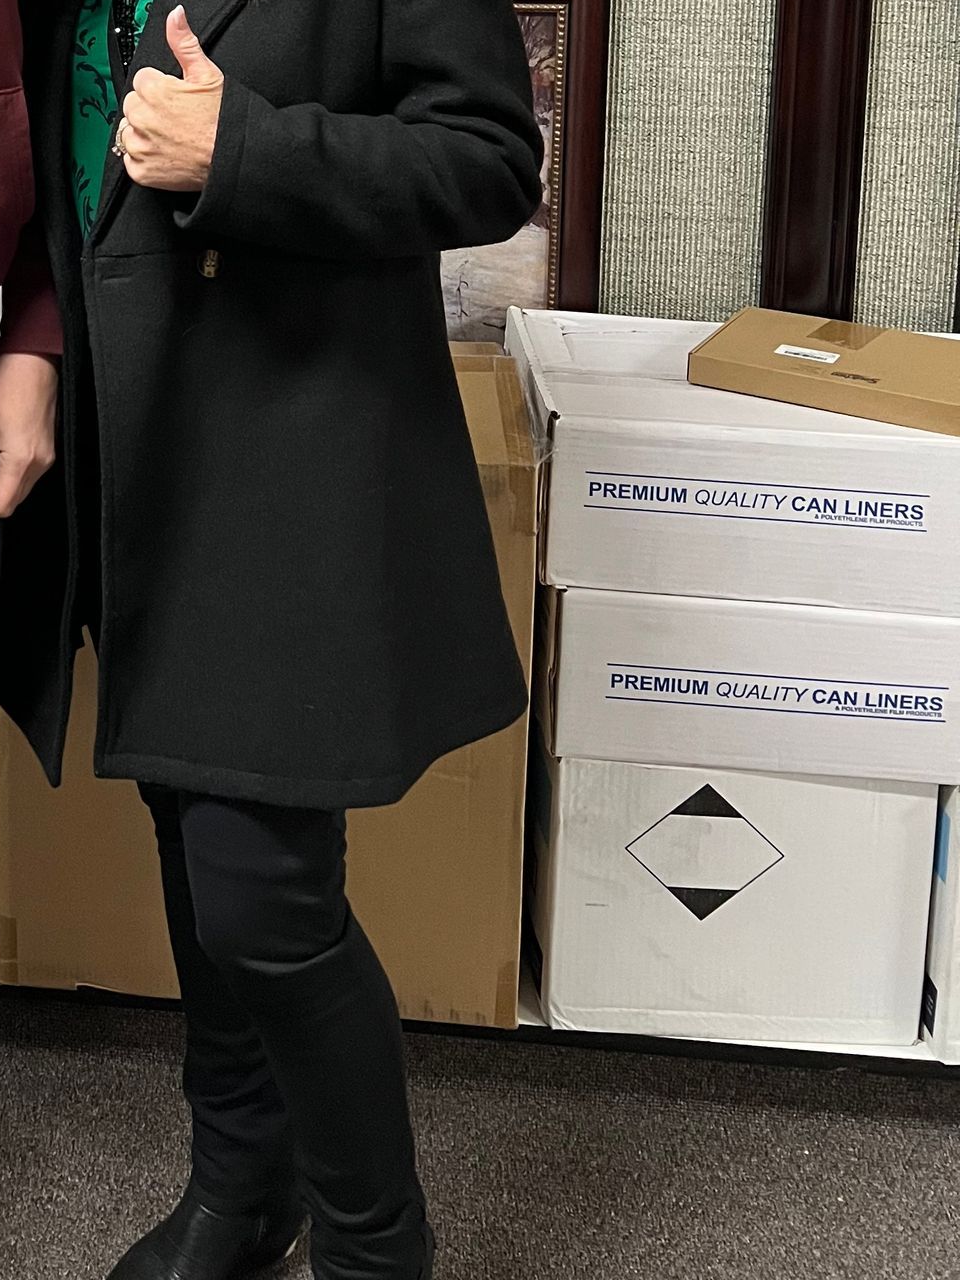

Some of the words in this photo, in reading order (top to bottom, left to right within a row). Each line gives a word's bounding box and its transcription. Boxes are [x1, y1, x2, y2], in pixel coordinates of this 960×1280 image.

[588, 481, 688, 504] PREMIUM
[694, 488, 788, 511] QUALITY
[791, 496, 837, 514] CAN
[844, 500, 924, 520] LINERS
[886, 519, 923, 527] PRODUCTS
[610, 673, 709, 696] PREMIUM
[716, 681, 809, 702] QUALITY
[812, 689, 858, 706] CAN
[864, 692, 944, 711] LINERS
[906, 710, 942, 718] PRODUCTS
